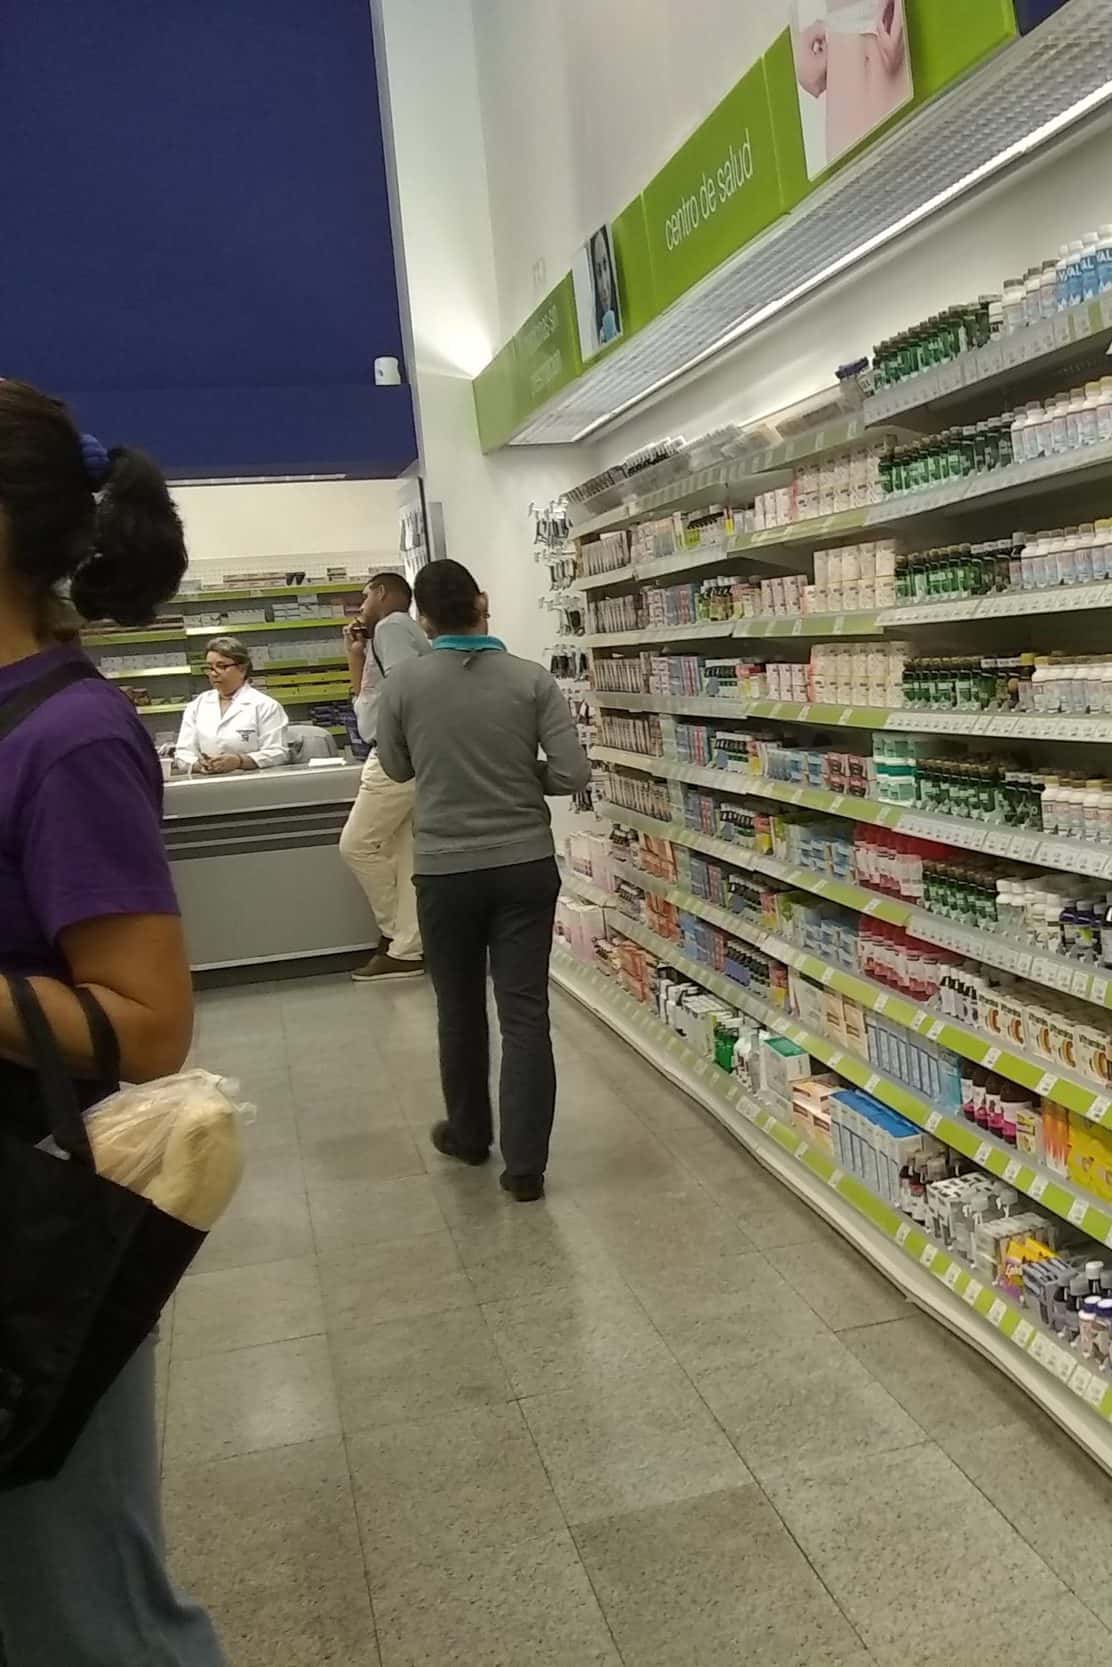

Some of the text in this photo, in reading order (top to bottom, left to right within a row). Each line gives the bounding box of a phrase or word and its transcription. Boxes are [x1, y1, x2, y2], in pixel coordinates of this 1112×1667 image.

[665, 127, 753, 251] centro de salud
